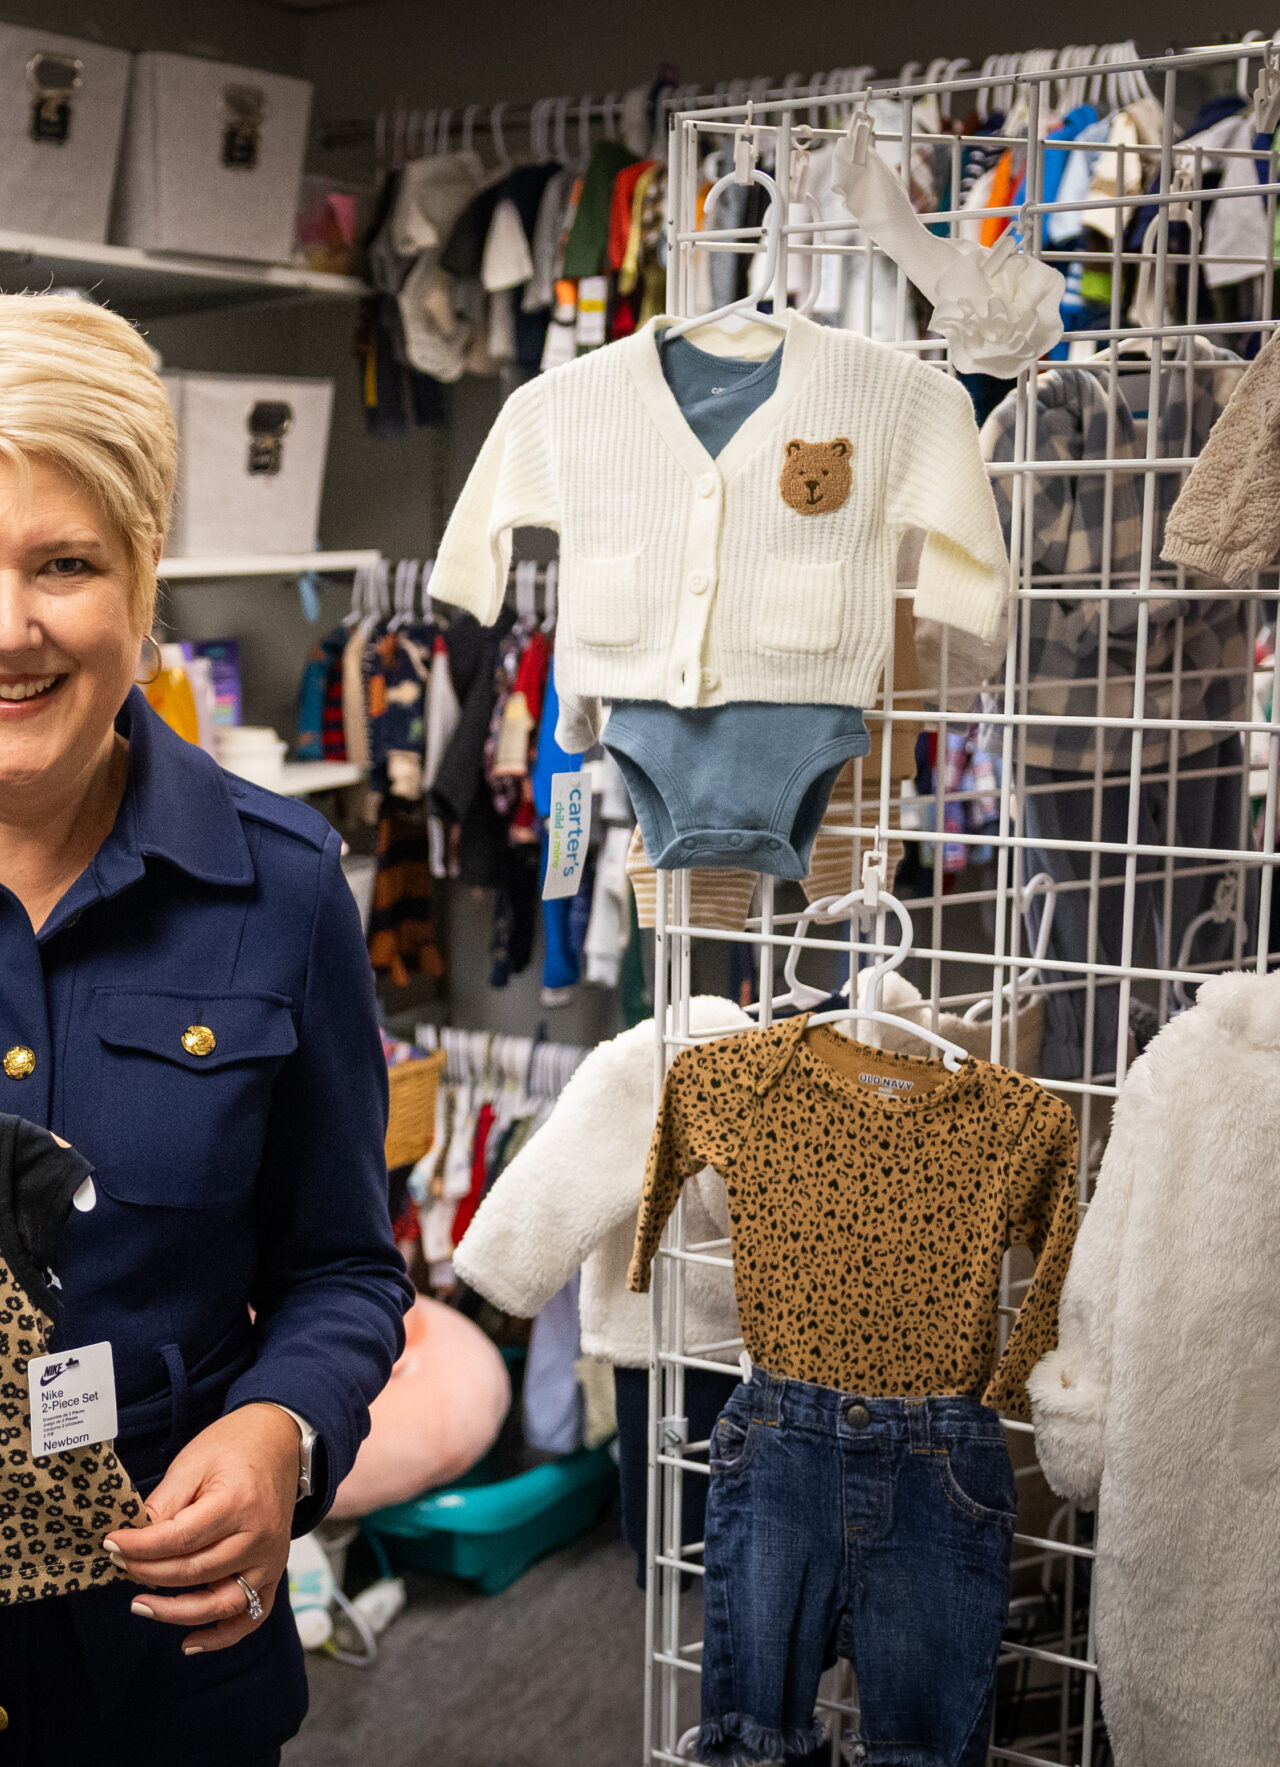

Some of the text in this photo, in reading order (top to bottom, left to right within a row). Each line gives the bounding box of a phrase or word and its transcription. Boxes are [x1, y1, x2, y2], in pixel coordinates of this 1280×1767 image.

[554, 802, 564, 828] child
[563, 788, 583, 877] carter's
[552, 841, 561, 868] mine
[859, 1073, 914, 1091] OLD NAVY
[44, 1363, 63, 1377] NIKE
[41, 1390, 63, 1401] Nike
[42, 1391, 99, 1413] 2-Piece Set
[44, 1434, 89, 1451] Newborn
